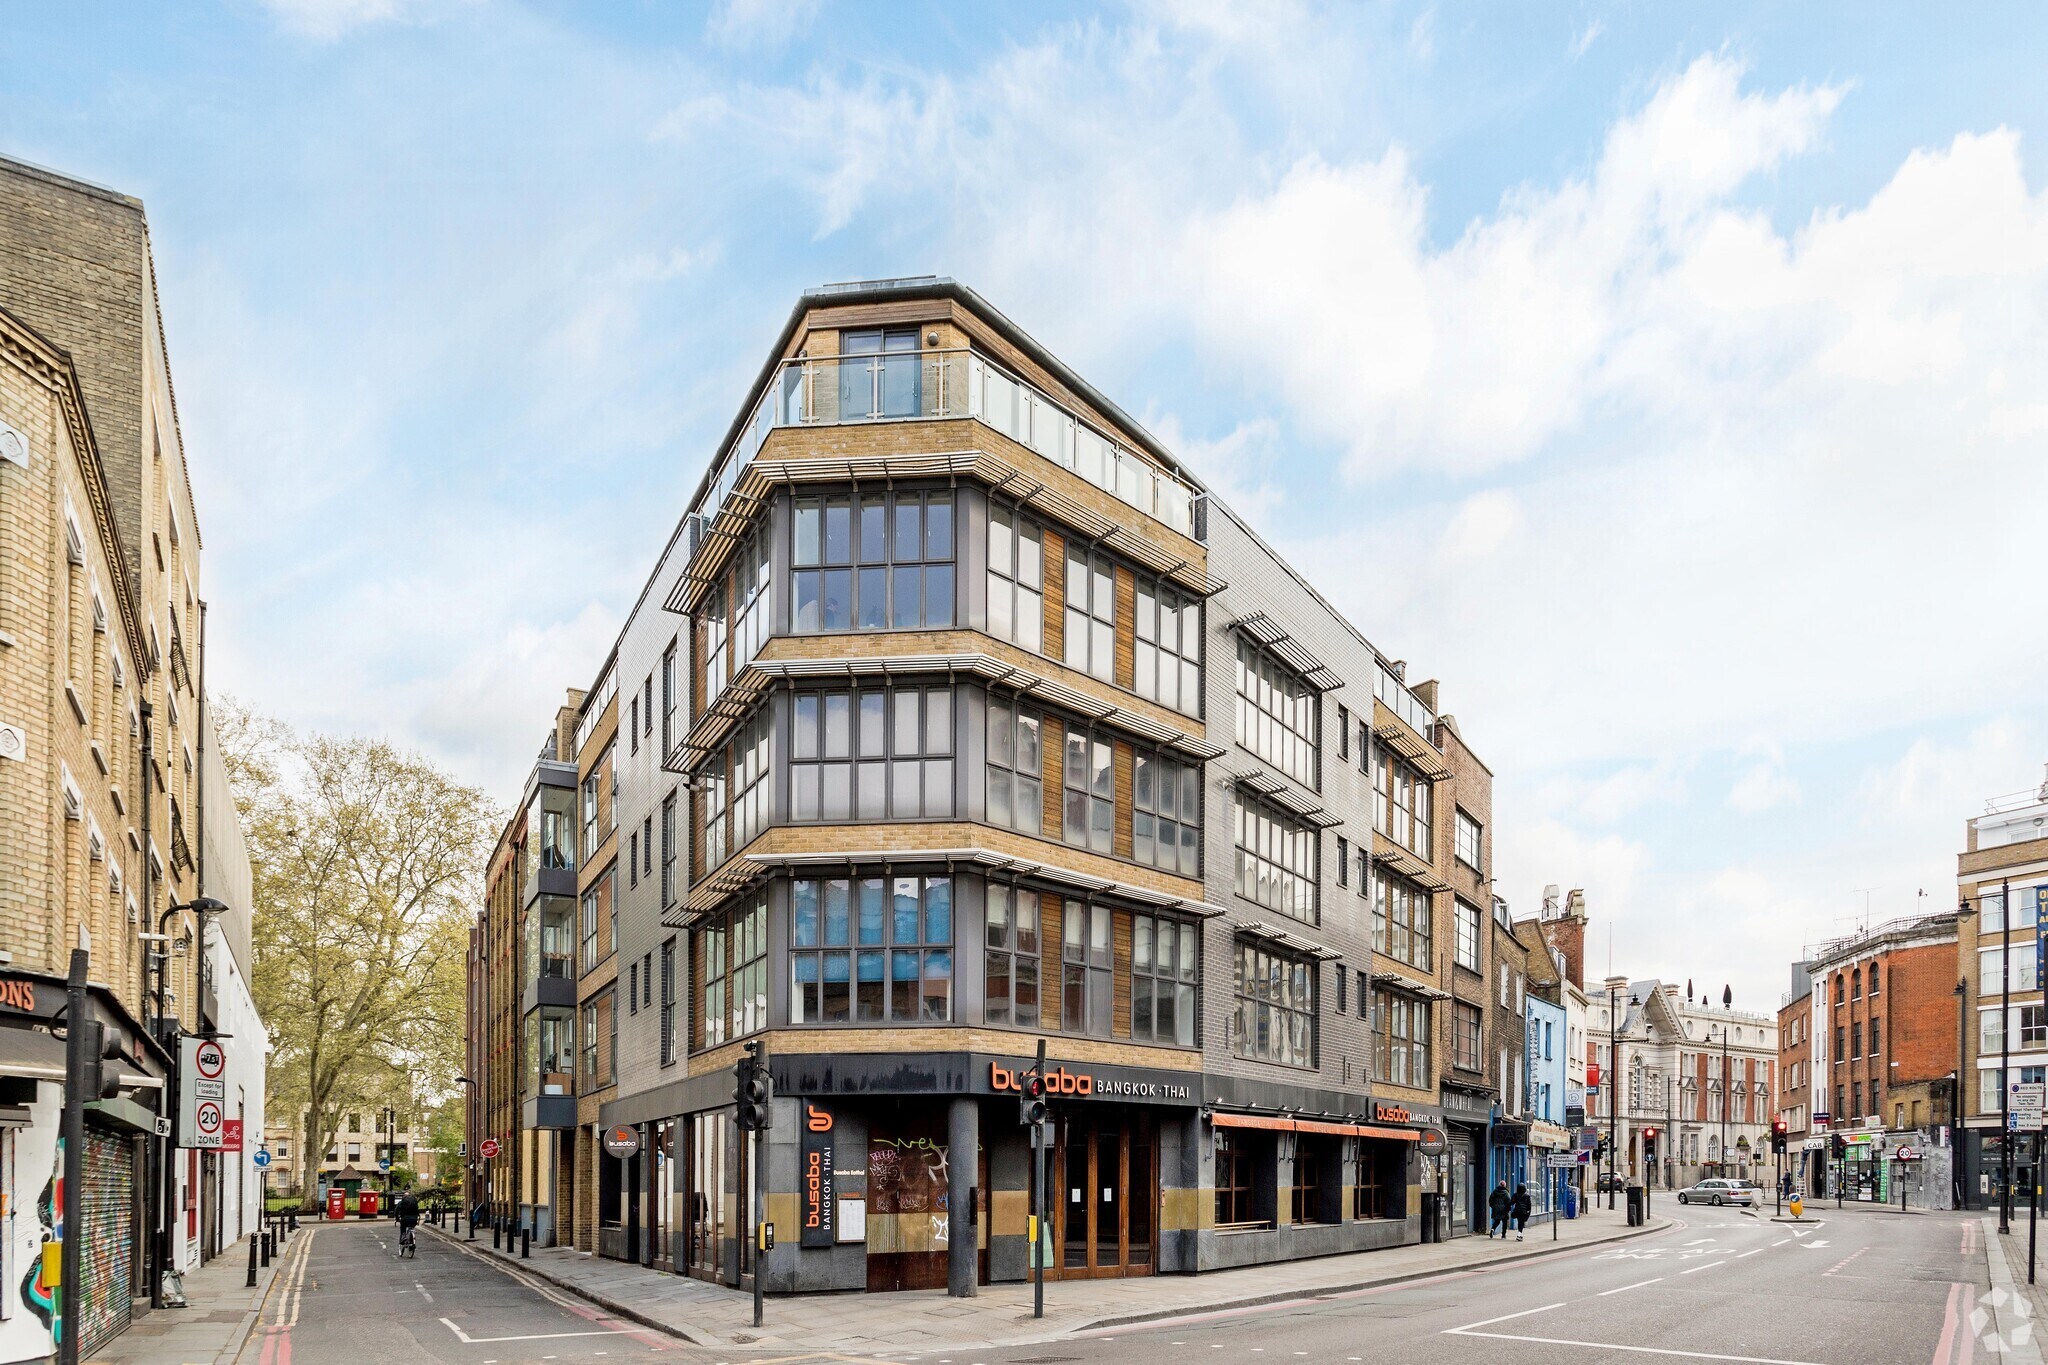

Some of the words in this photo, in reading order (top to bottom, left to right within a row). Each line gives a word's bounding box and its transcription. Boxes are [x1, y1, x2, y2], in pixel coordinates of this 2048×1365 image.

[991, 1061, 1092, 1094] buaba
[1097, 1080, 1156, 1096] BANGKOK
[1164, 1085, 1190, 1098] THAI
[202, 1111, 218, 1124] 20
[1376, 1102, 1410, 1123] busaba
[198, 1136, 220, 1145] ZONE
[806, 1152, 820, 1228] busaba
